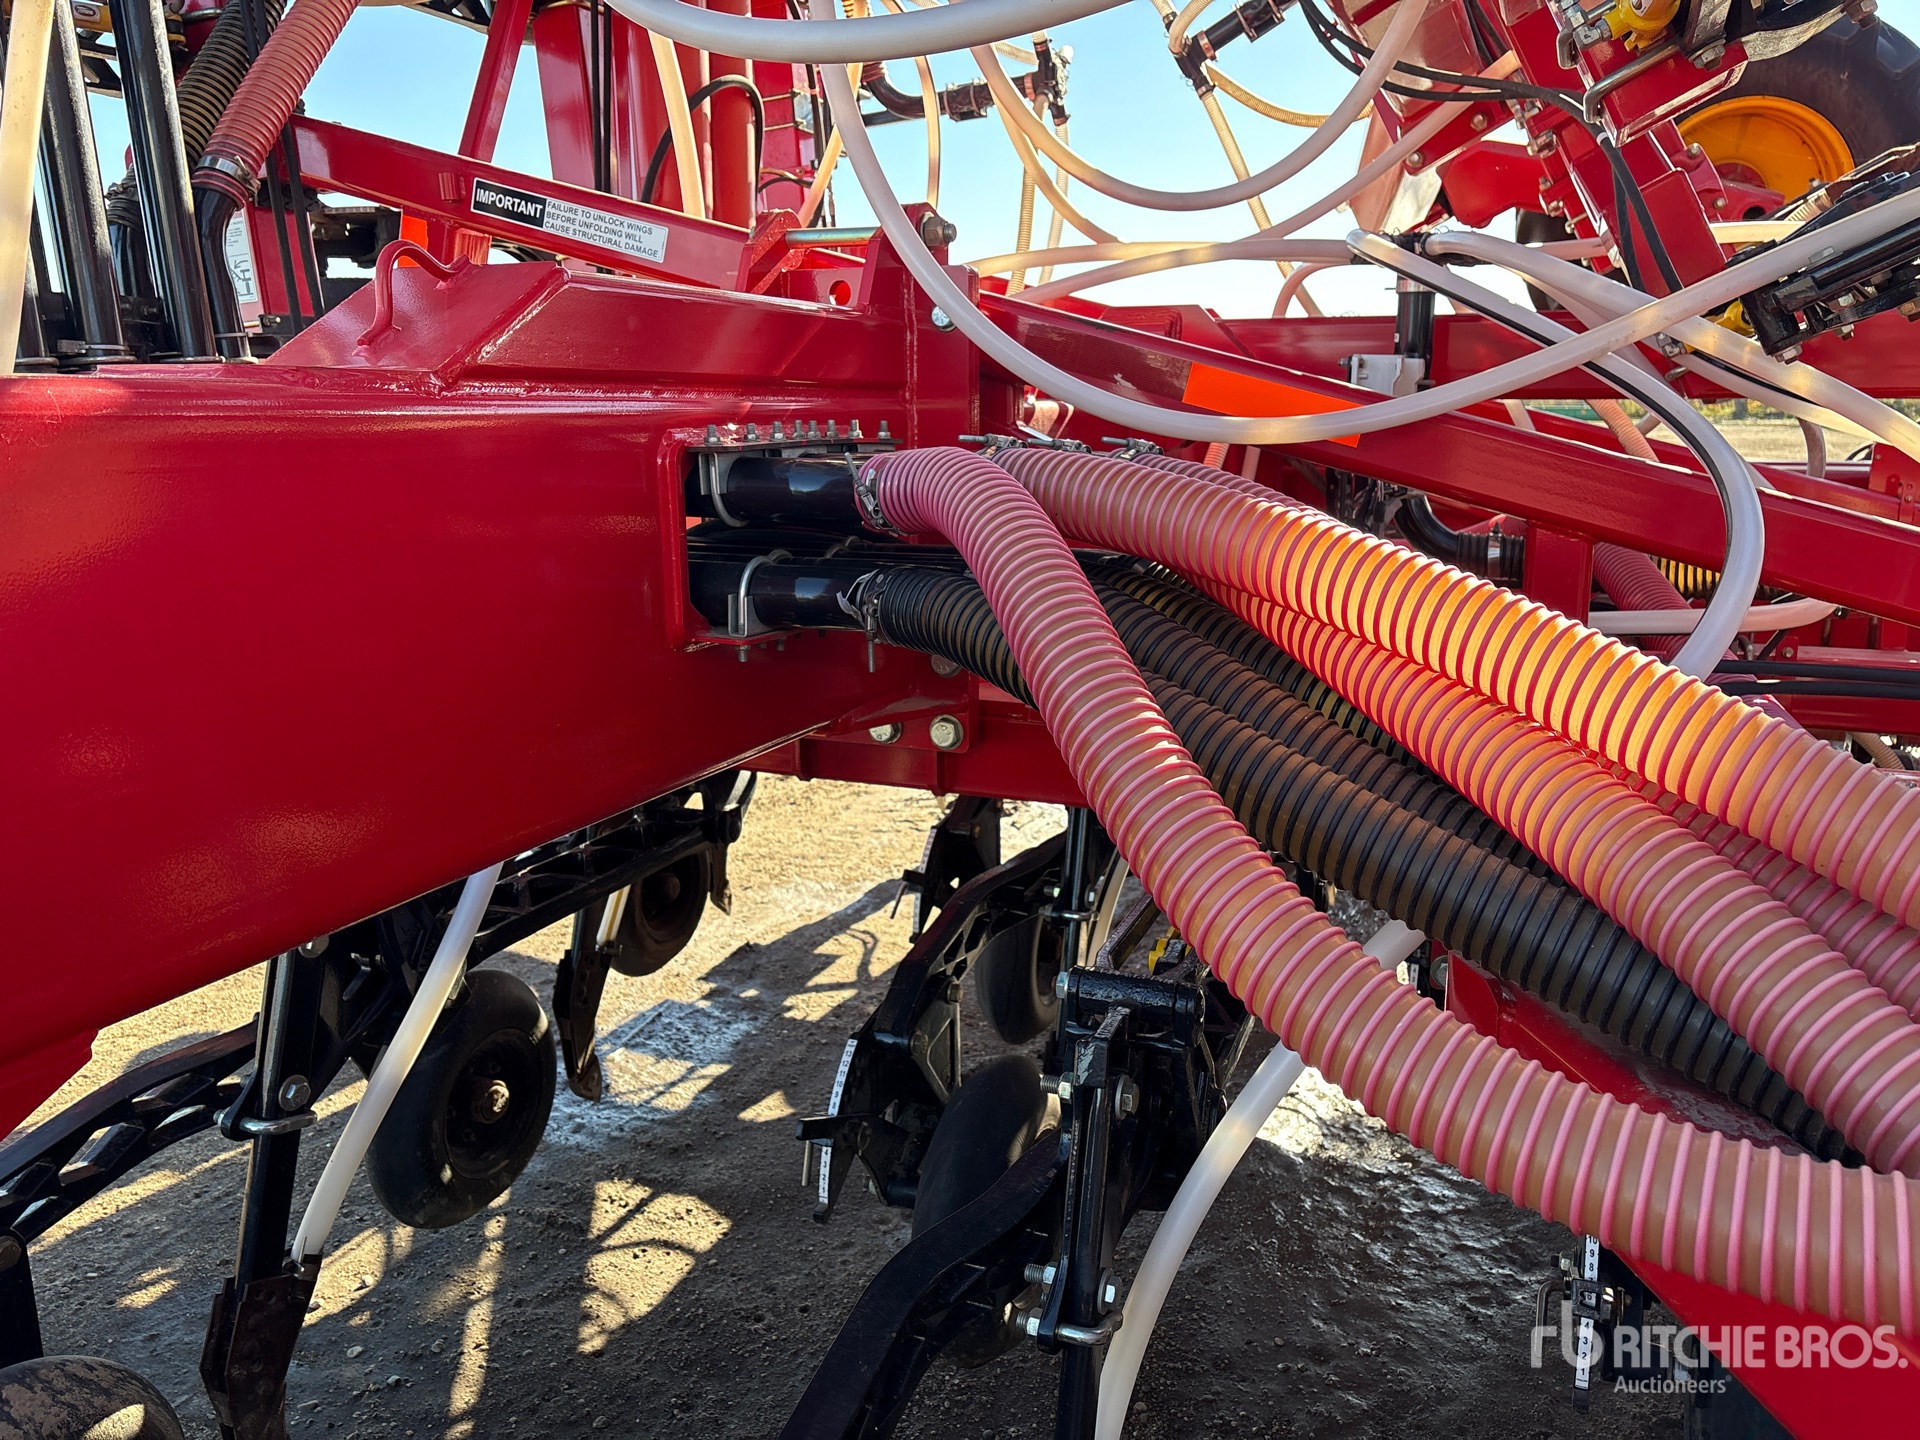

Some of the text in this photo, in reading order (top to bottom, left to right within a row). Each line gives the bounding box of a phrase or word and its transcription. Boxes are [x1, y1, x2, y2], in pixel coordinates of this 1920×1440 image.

[476, 188, 543, 218] IMPORTANT
[547, 201, 653, 235] FAILURE TO UNLOCK WINGS
[544, 221, 661, 259] CAUSE STRUCTURAL DAMAGE.
[546, 211, 643, 243] BEFORE UNFOLDING WILL
